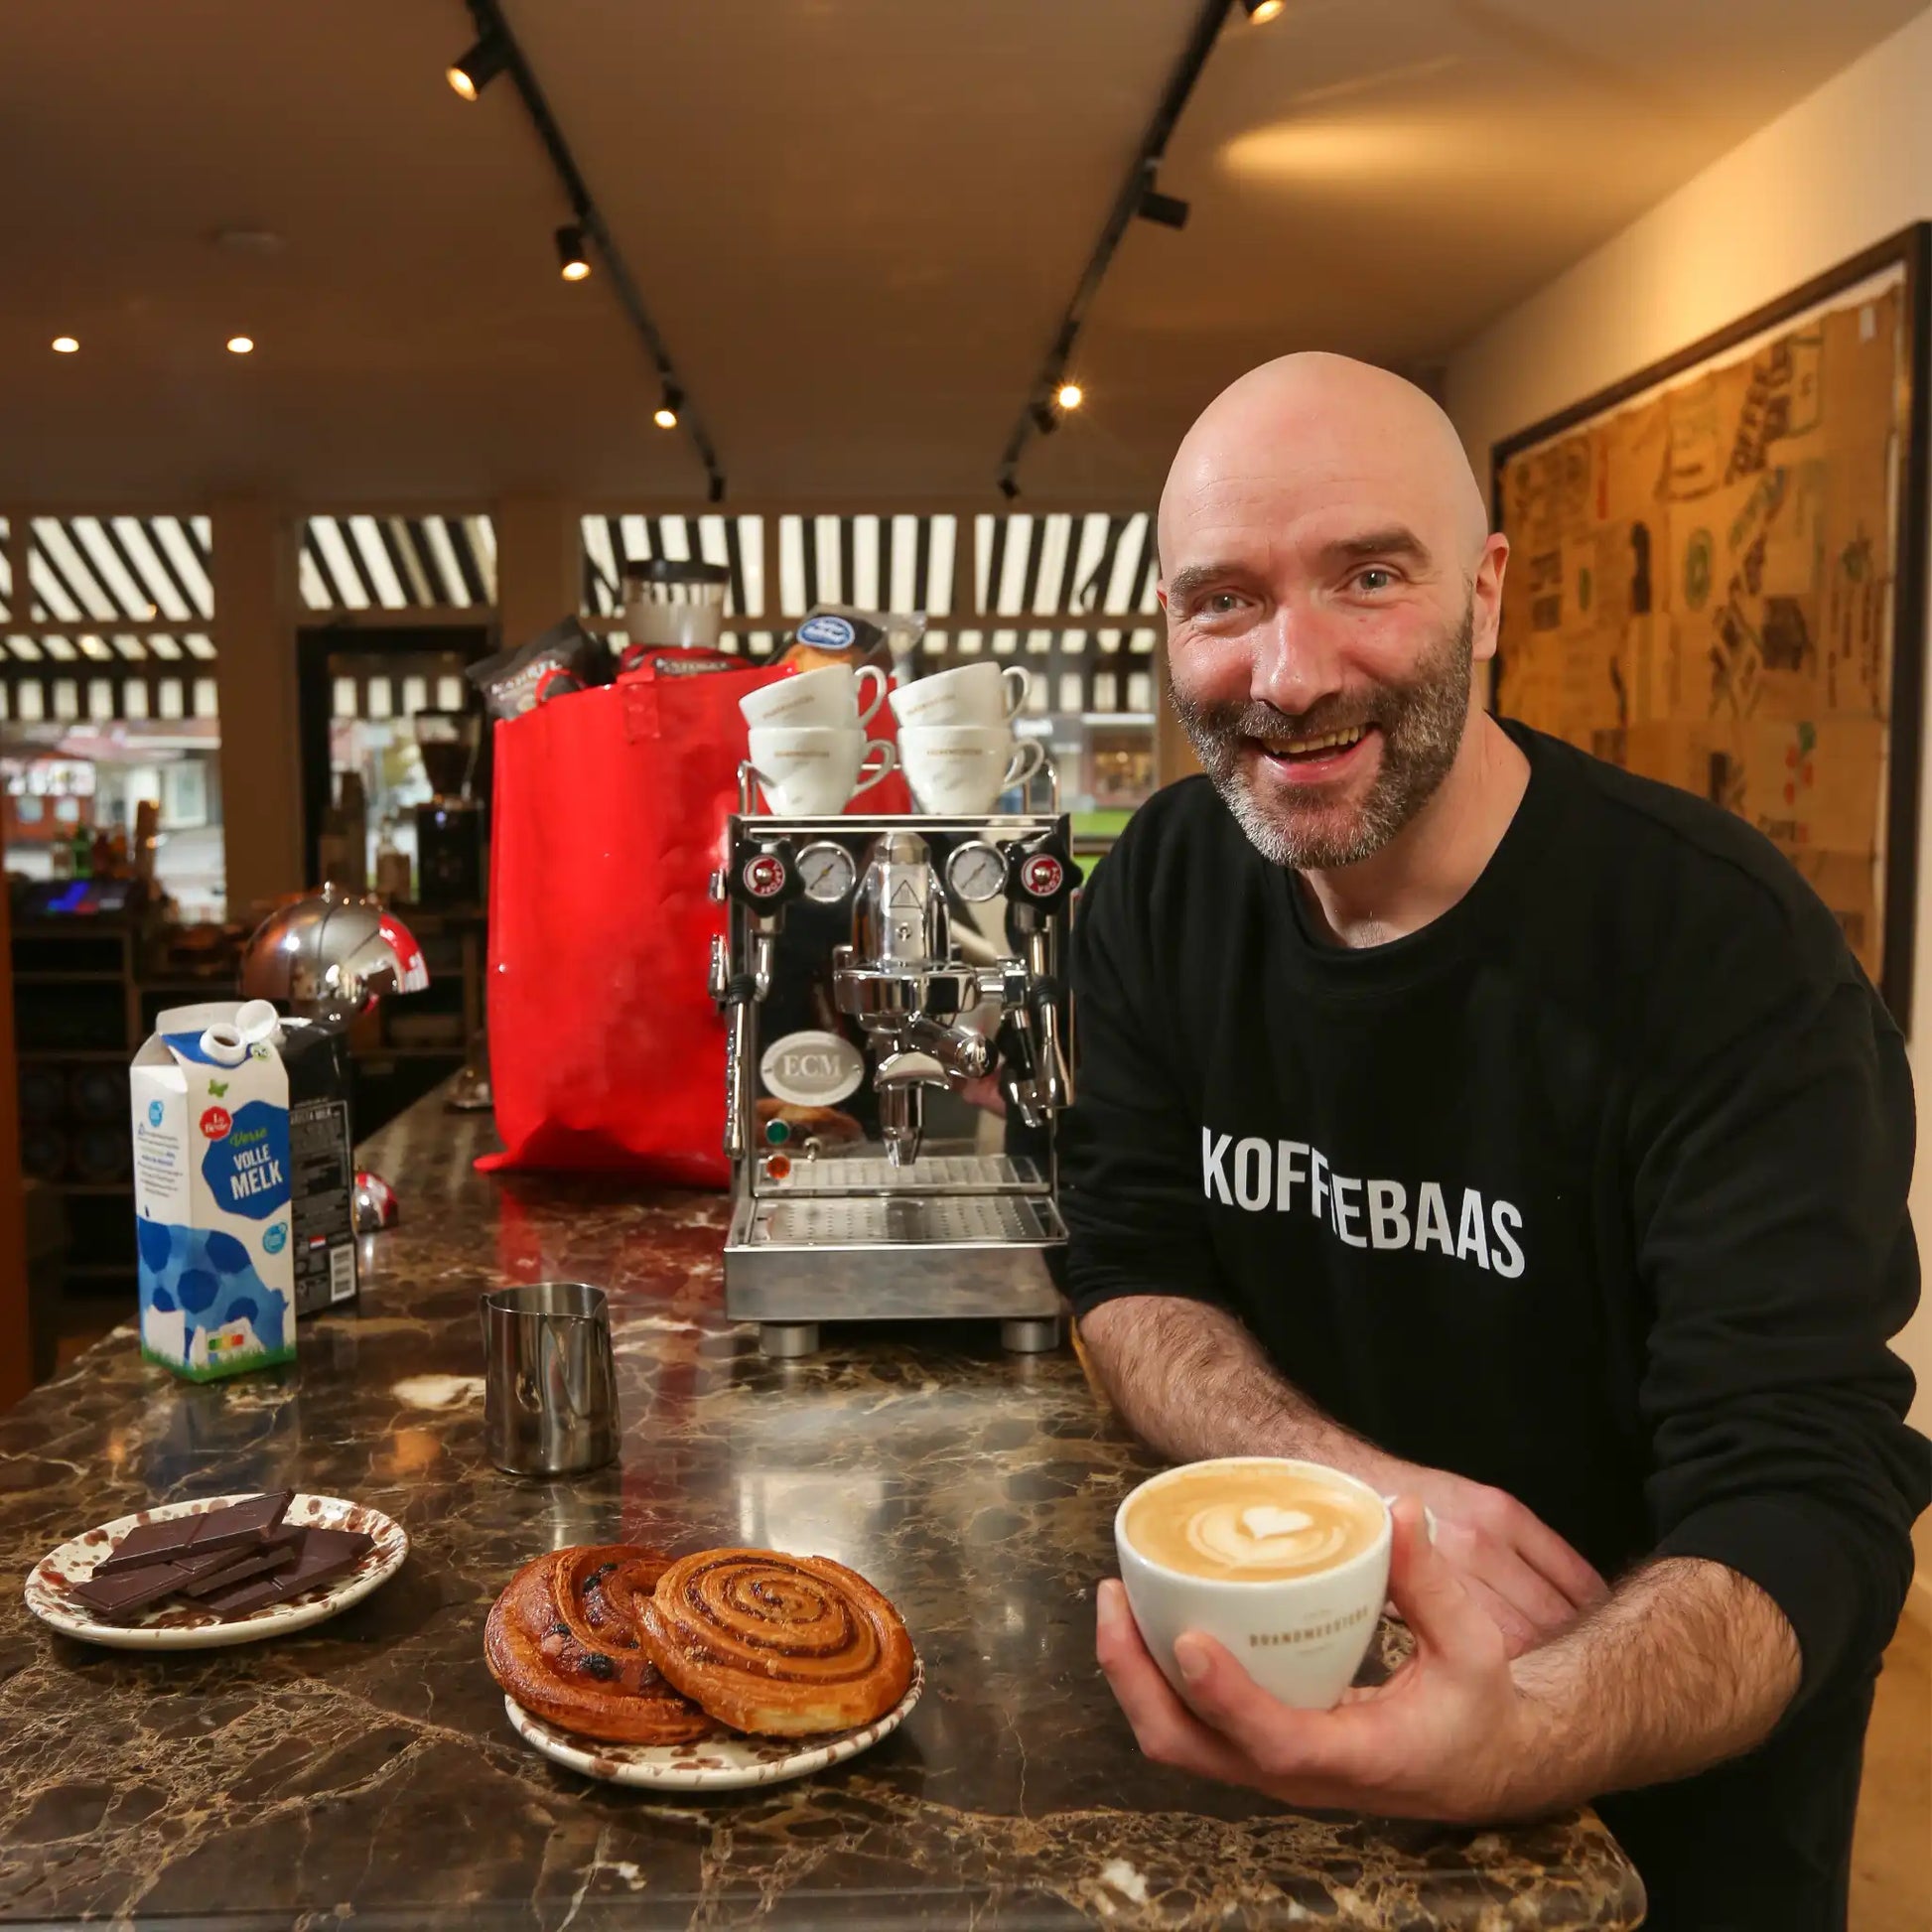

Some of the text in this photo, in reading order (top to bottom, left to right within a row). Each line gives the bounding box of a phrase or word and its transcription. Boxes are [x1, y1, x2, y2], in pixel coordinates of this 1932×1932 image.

[783, 1054, 842, 1077] ECM
[233, 1143, 271, 1171] VOLLE
[230, 1159, 283, 1200] MELK
[1202, 1126, 1526, 1279] KOFFIEBAAS
